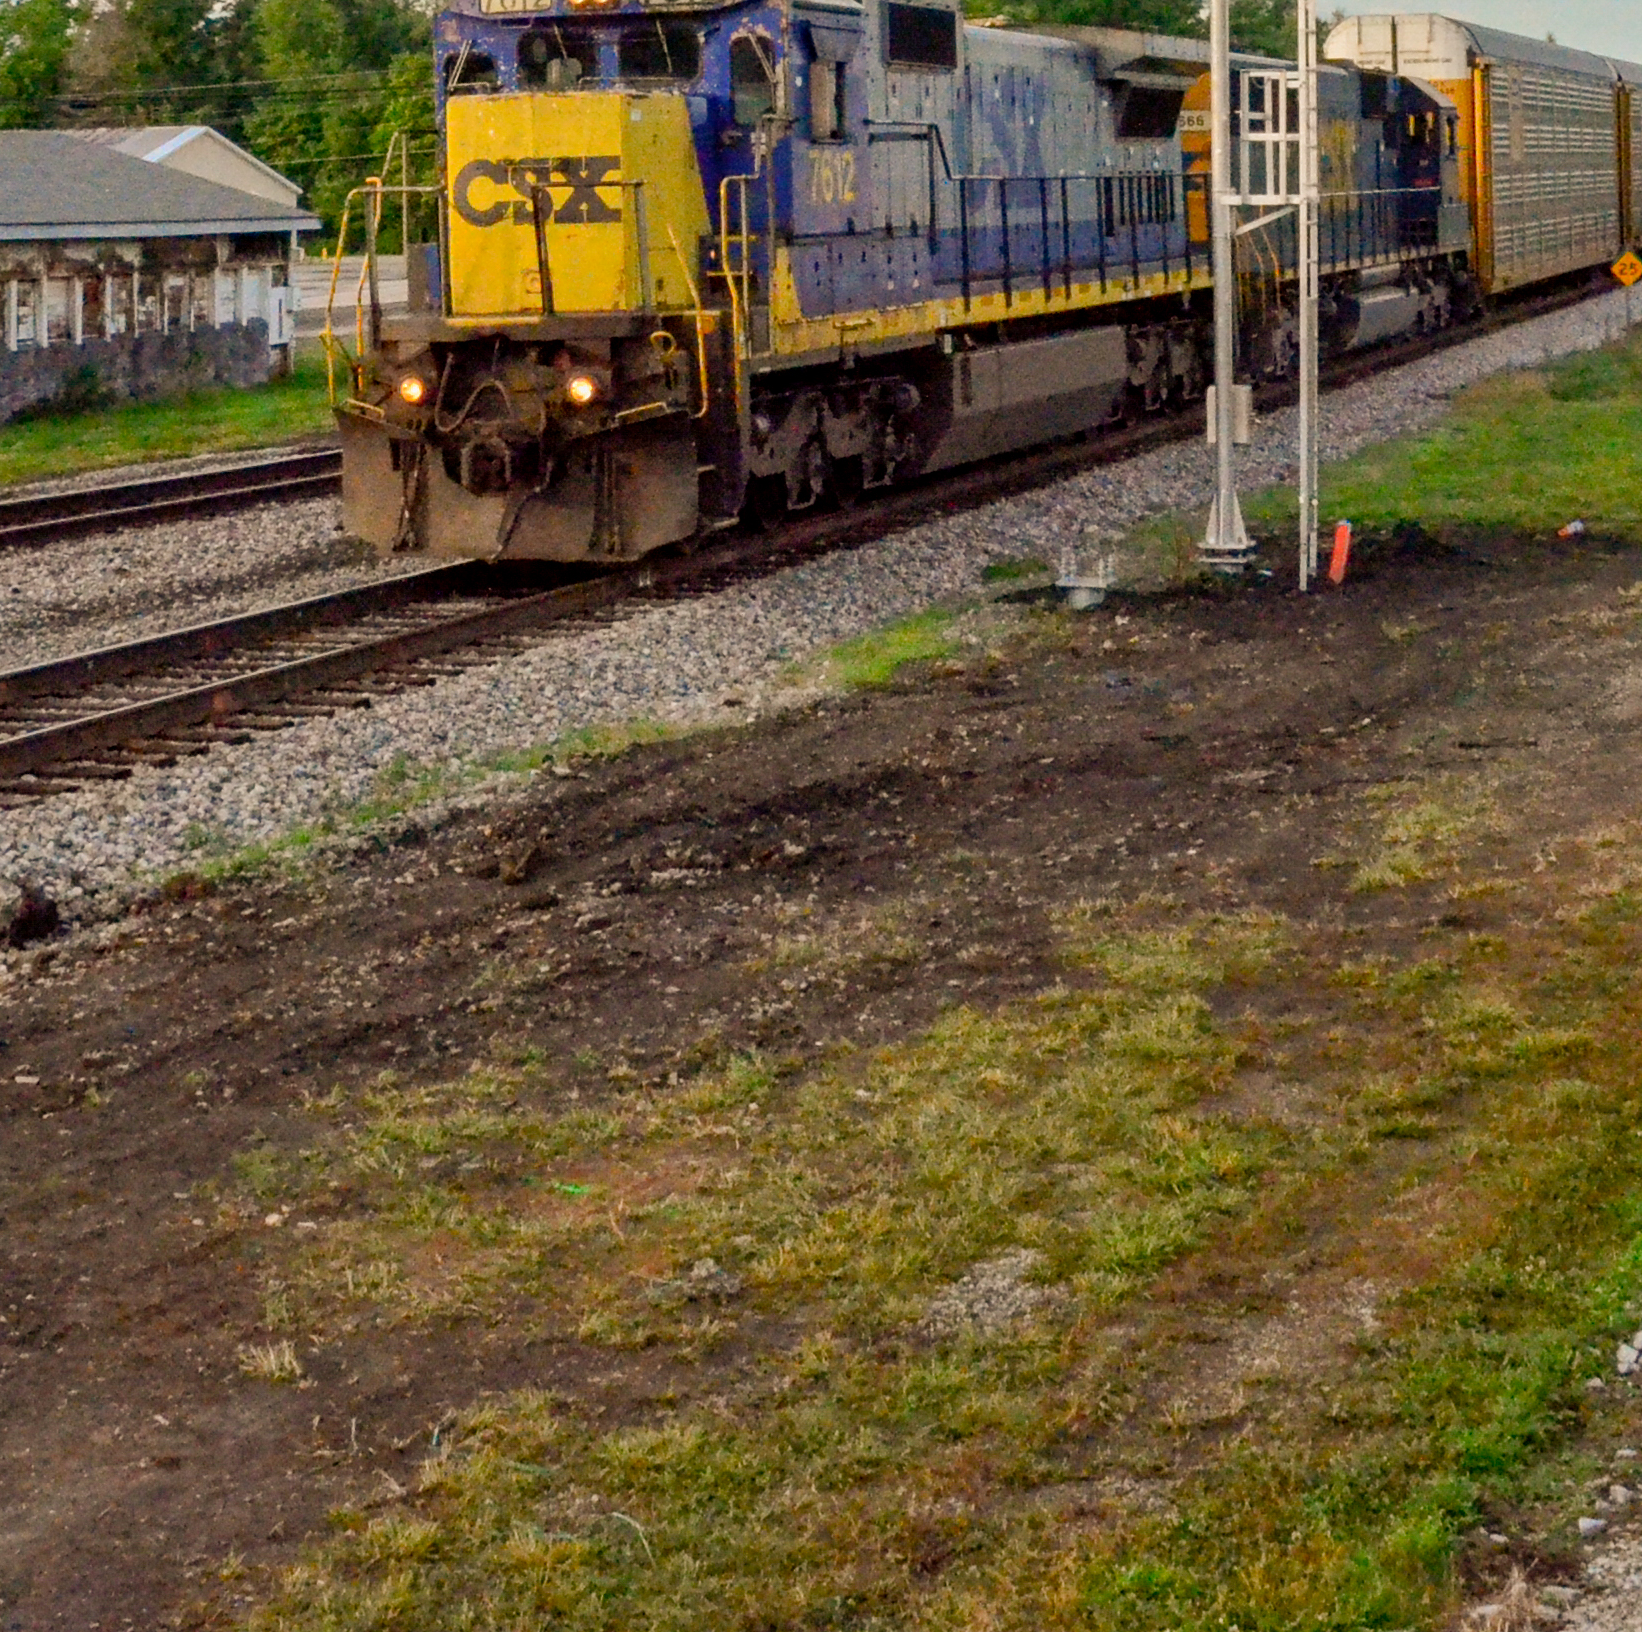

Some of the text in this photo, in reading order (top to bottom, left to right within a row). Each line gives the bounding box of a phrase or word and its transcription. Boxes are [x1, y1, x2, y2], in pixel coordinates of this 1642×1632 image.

[453, 155, 623, 228] CSX
[808, 149, 856, 203] 7612
[1618, 262, 1638, 276] 25
